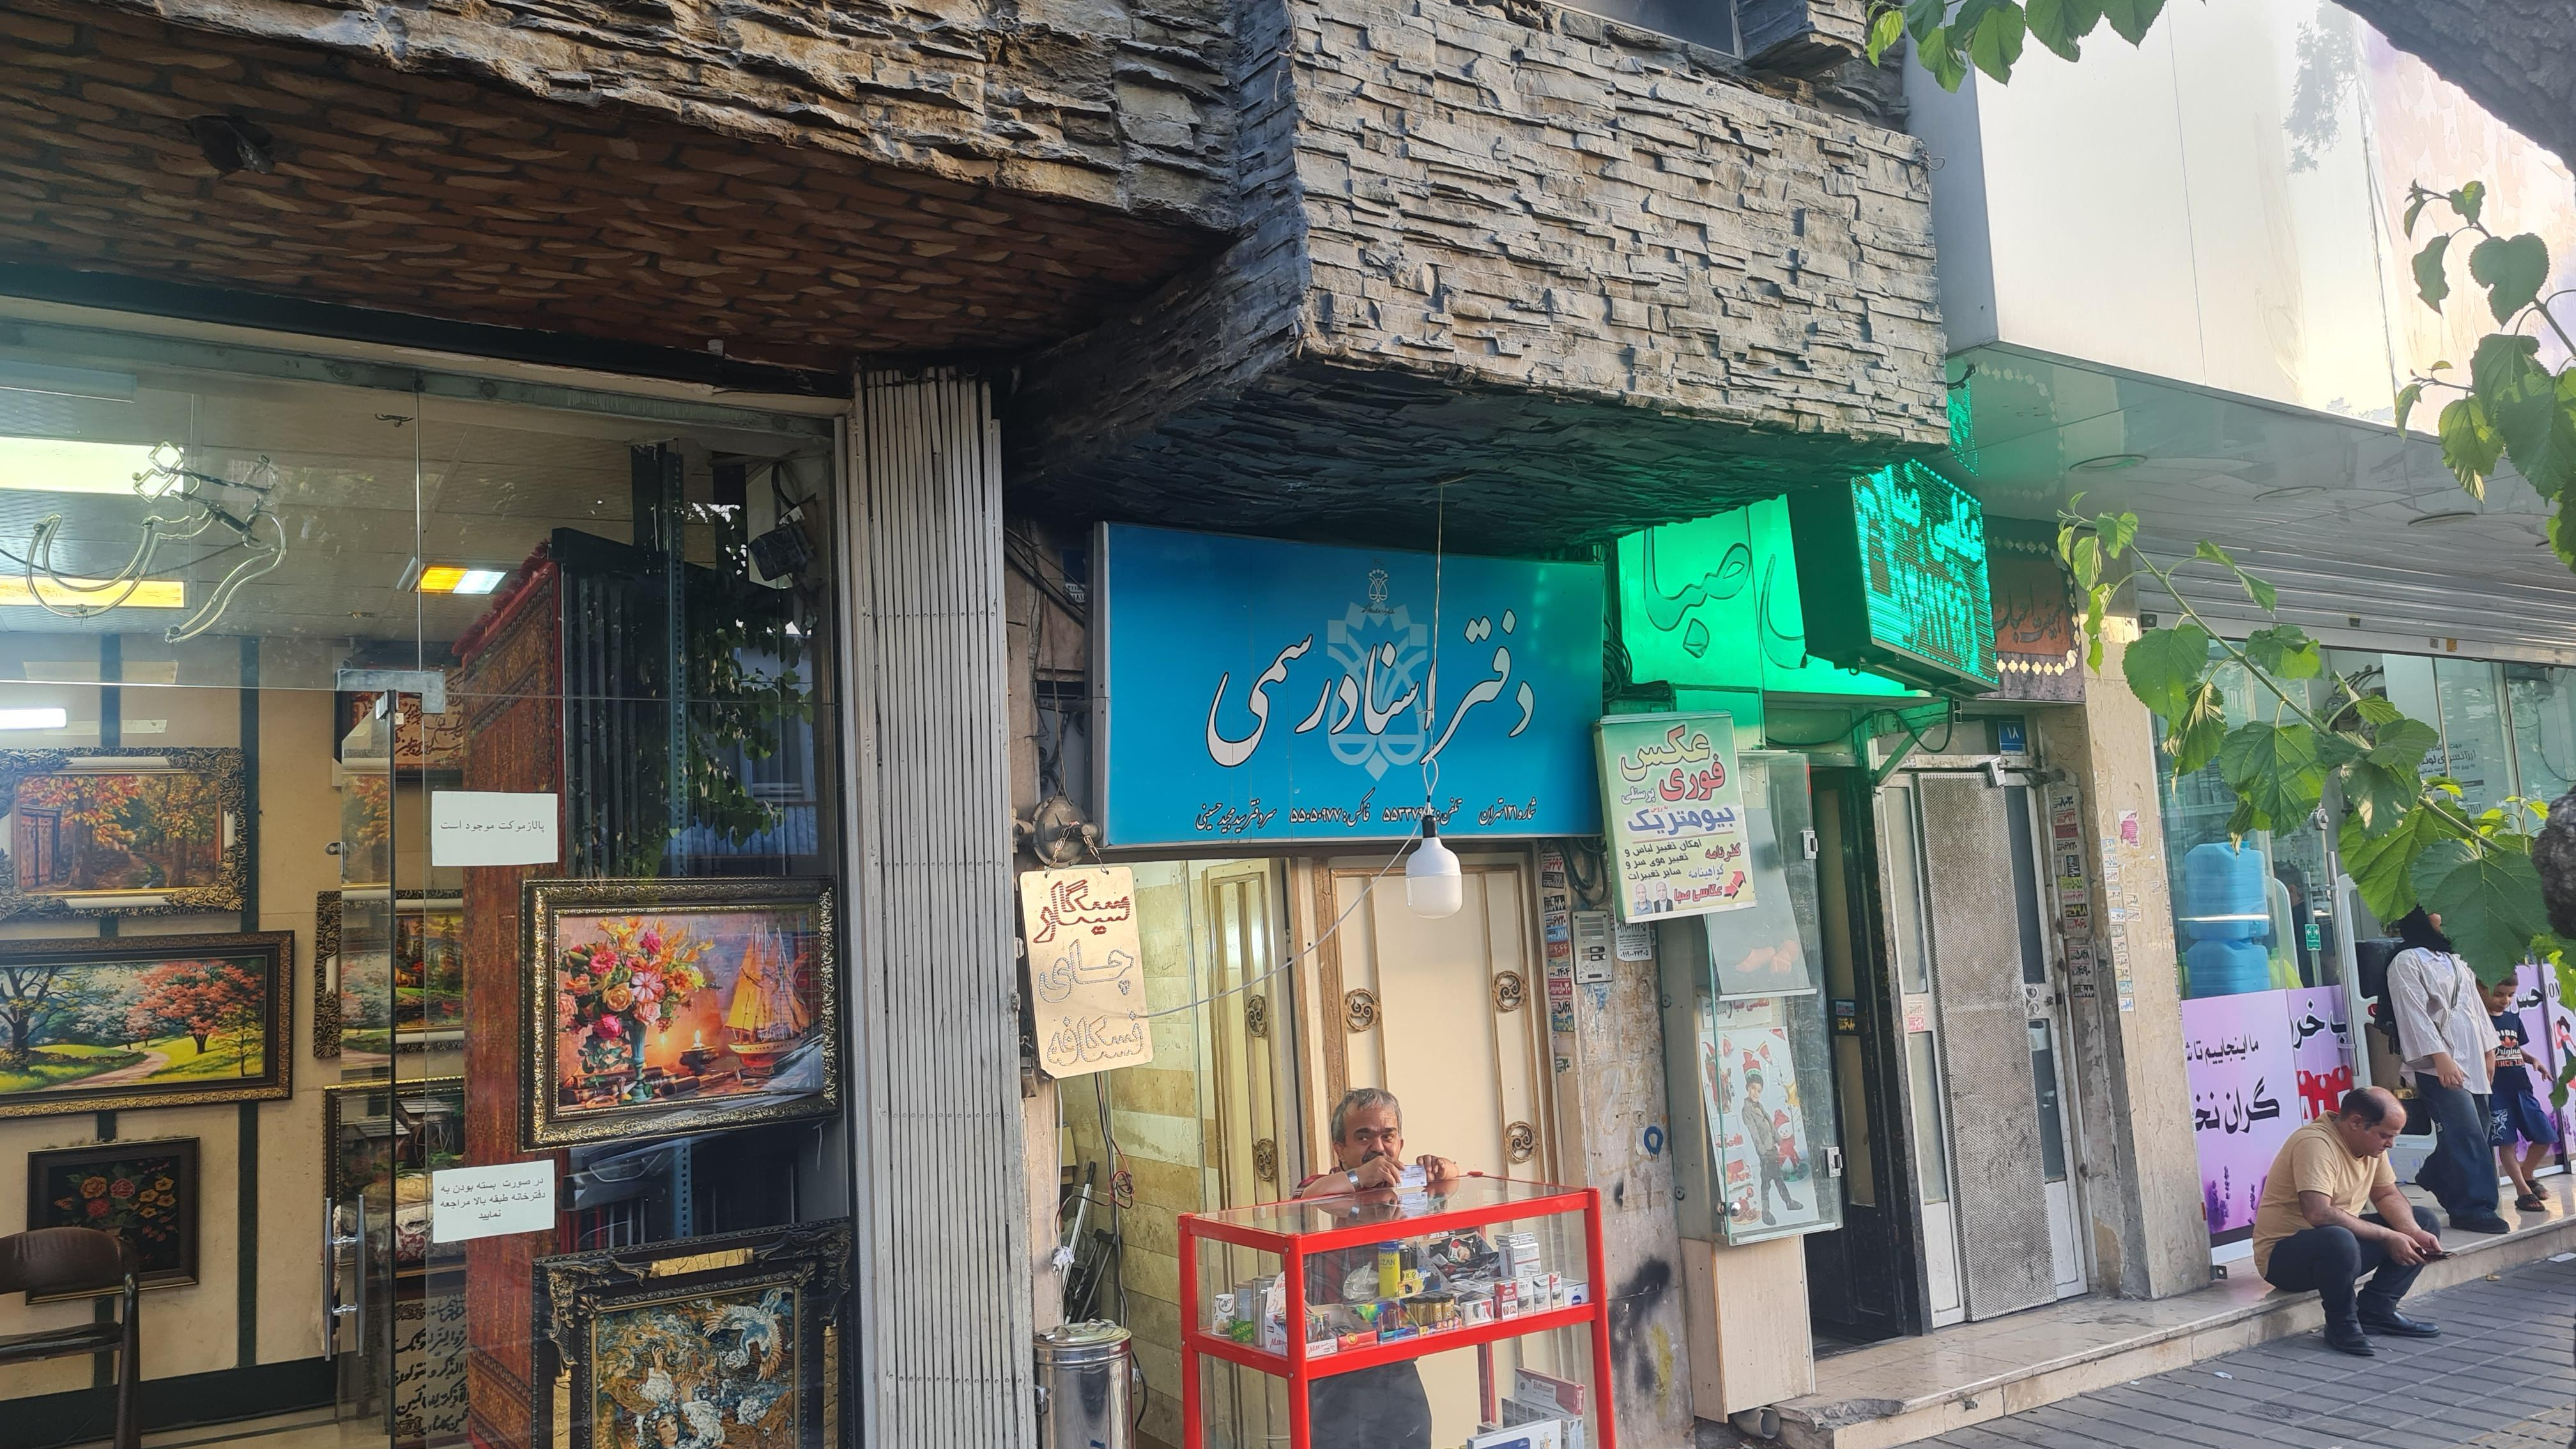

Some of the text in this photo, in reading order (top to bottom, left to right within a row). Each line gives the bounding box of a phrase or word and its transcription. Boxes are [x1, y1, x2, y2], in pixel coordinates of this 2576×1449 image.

[1206, 609, 1535, 768] دفتر اسناد رسمی
[2007, 726, 2020, 740] ۱۸
[1620, 724, 1711, 783] عکس
[1659, 753, 1726, 802] فوری
[440, 820, 462, 830] است
[1195, 802, 1223, 831] حسینی
[1627, 806, 1736, 836] بیومتریک
[465, 824, 494, 832] موجود
[1624, 838, 1703, 857] امکان تغییر لباس و
[1625, 853, 1689, 870] تغییر موی سر و
[1627, 866, 1682, 882] سایر تغییرات
[1673, 884, 1722, 902] عکاسی صبا
[1032, 878, 1131, 944] سیگار
[1039, 939, 1134, 1004] چای
[1046, 1010, 1144, 1067] نسکافه
[2248, 1034, 2259, 1053] ما
[2193, 1039, 2203, 1061] تا
[2205, 1035, 2248, 1068] اینجاییم
[2225, 1075, 2280, 1135] گران
[440, 1177, 544, 1195] در صورت بسته بودن به
[440, 1190, 546, 1209] دفترخانه طبقه بالا مراجعه
[478, 1209, 502, 1221] نمایید
